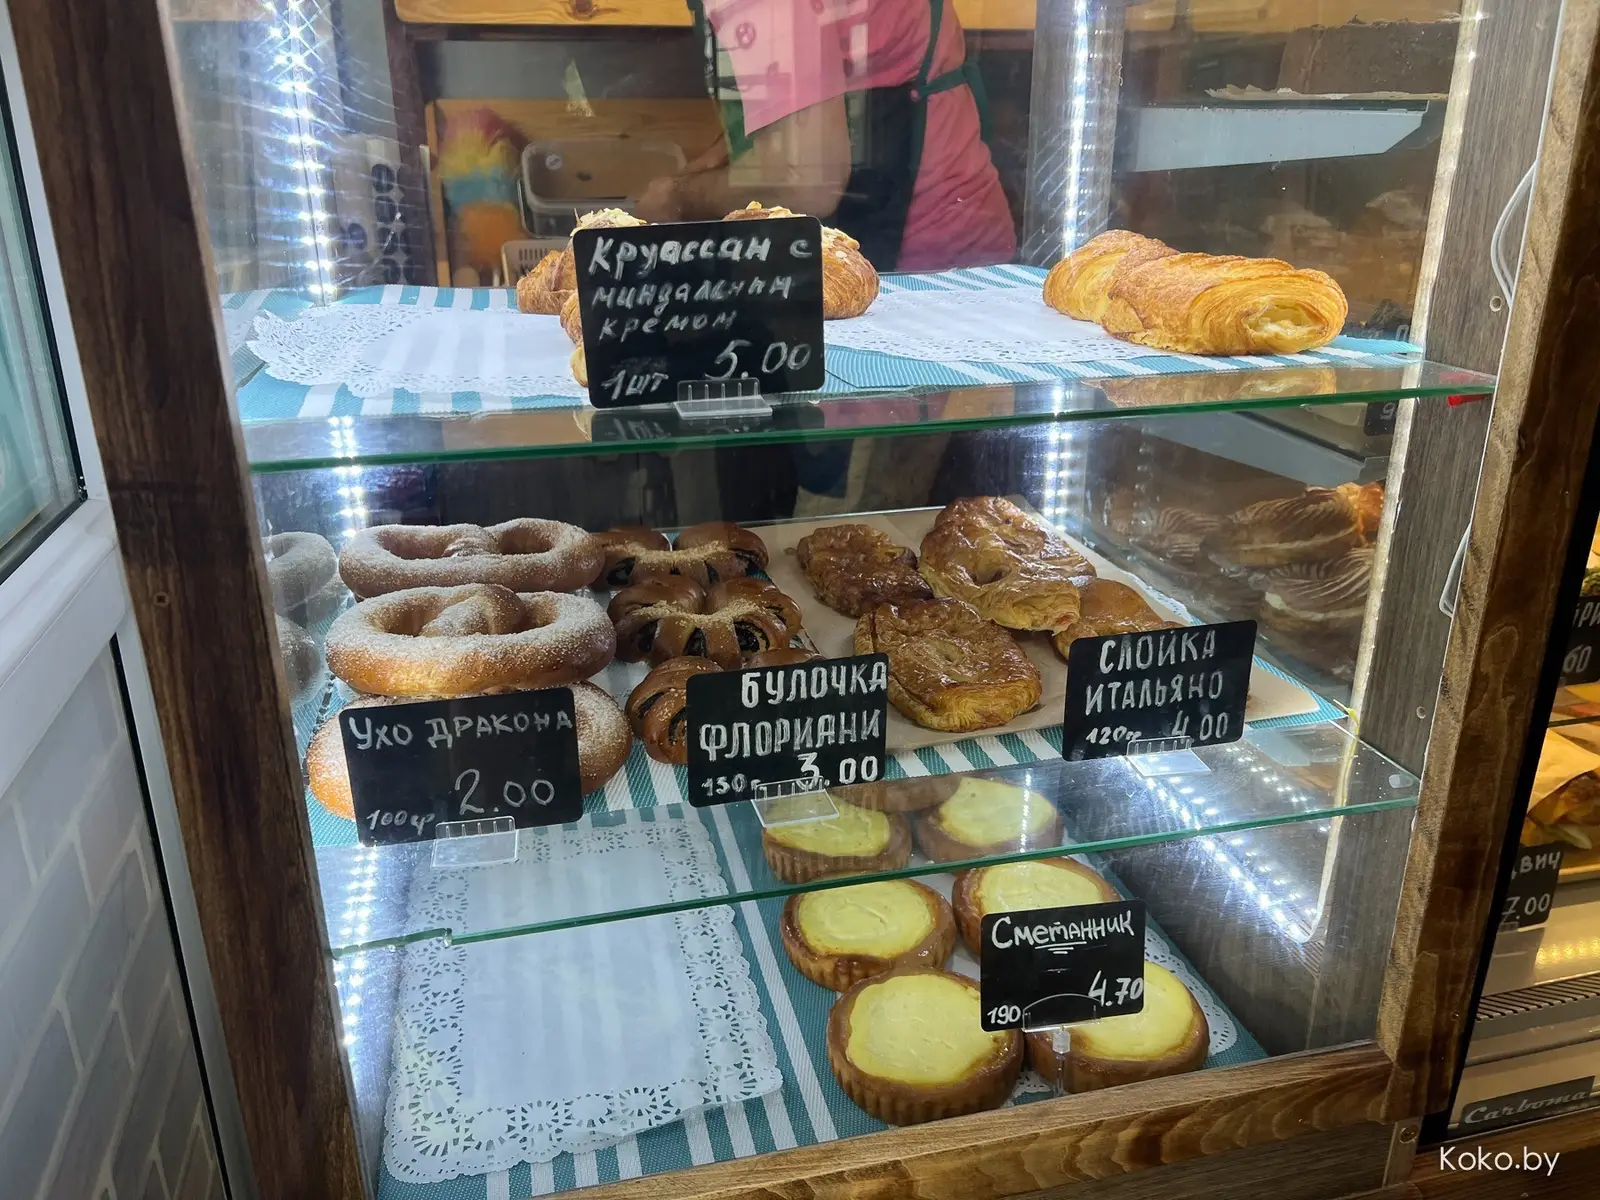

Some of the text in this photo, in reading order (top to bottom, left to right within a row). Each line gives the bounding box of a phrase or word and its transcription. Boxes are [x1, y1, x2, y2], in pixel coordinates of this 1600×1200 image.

[704, 339, 811, 380] 5.00
[1099, 629, 1216, 674] СЛОЙКА
[741, 660, 888, 708] БУЛОЧКА
[1085, 670, 1224, 716] ИТАЛЬЯНО
[425, 710, 573, 749] ДРАКОНА
[700, 708, 881, 762] ФЛОРИАНИ
[454, 768, 556, 816] 2.00
[796, 751, 879, 791] 3.00
[1511, 851, 1560, 879] ВИЧ
[991, 910, 1135, 949] Сметанник
[987, 970, 1145, 1025] 190 4.70
[1464, 1090, 1587, 1124] Carboma
